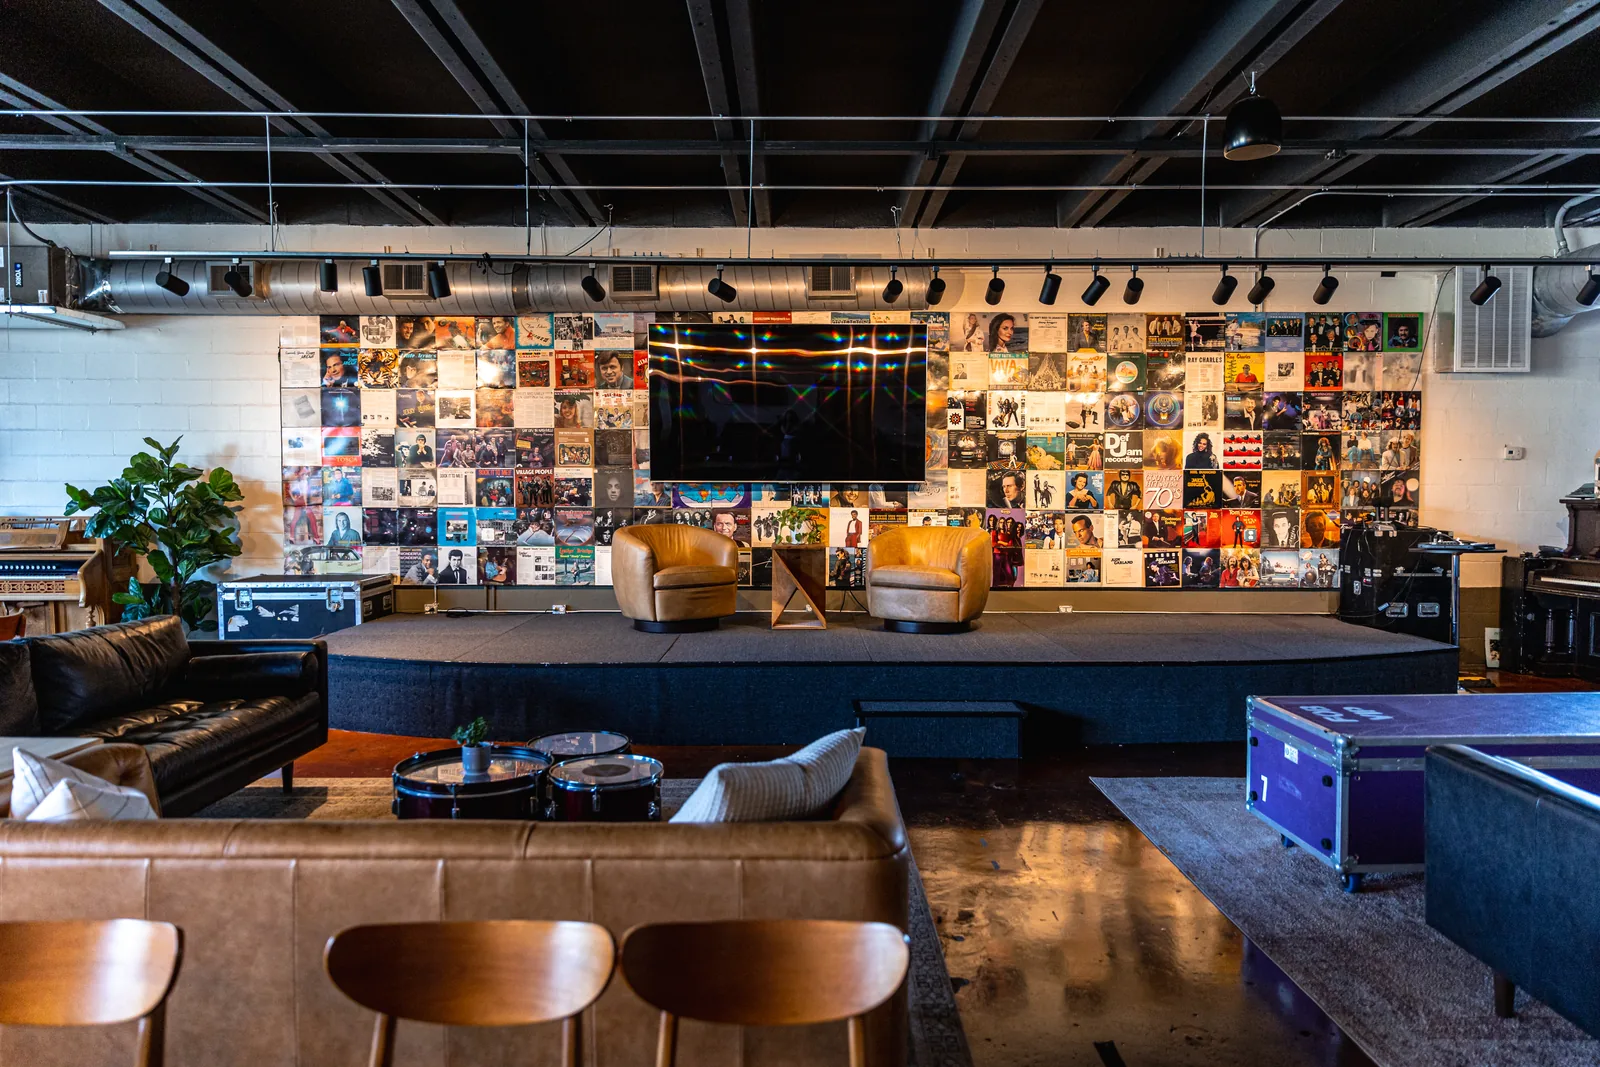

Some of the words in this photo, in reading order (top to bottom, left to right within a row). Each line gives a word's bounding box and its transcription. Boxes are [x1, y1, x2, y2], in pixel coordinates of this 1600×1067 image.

[1105, 433, 1130, 450] Def
[1110, 441, 1143, 458] Jam
[1105, 456, 1143, 464] recordings
[1145, 474, 1183, 482] COUNTRY
[1260, 774, 1268, 803] 7
